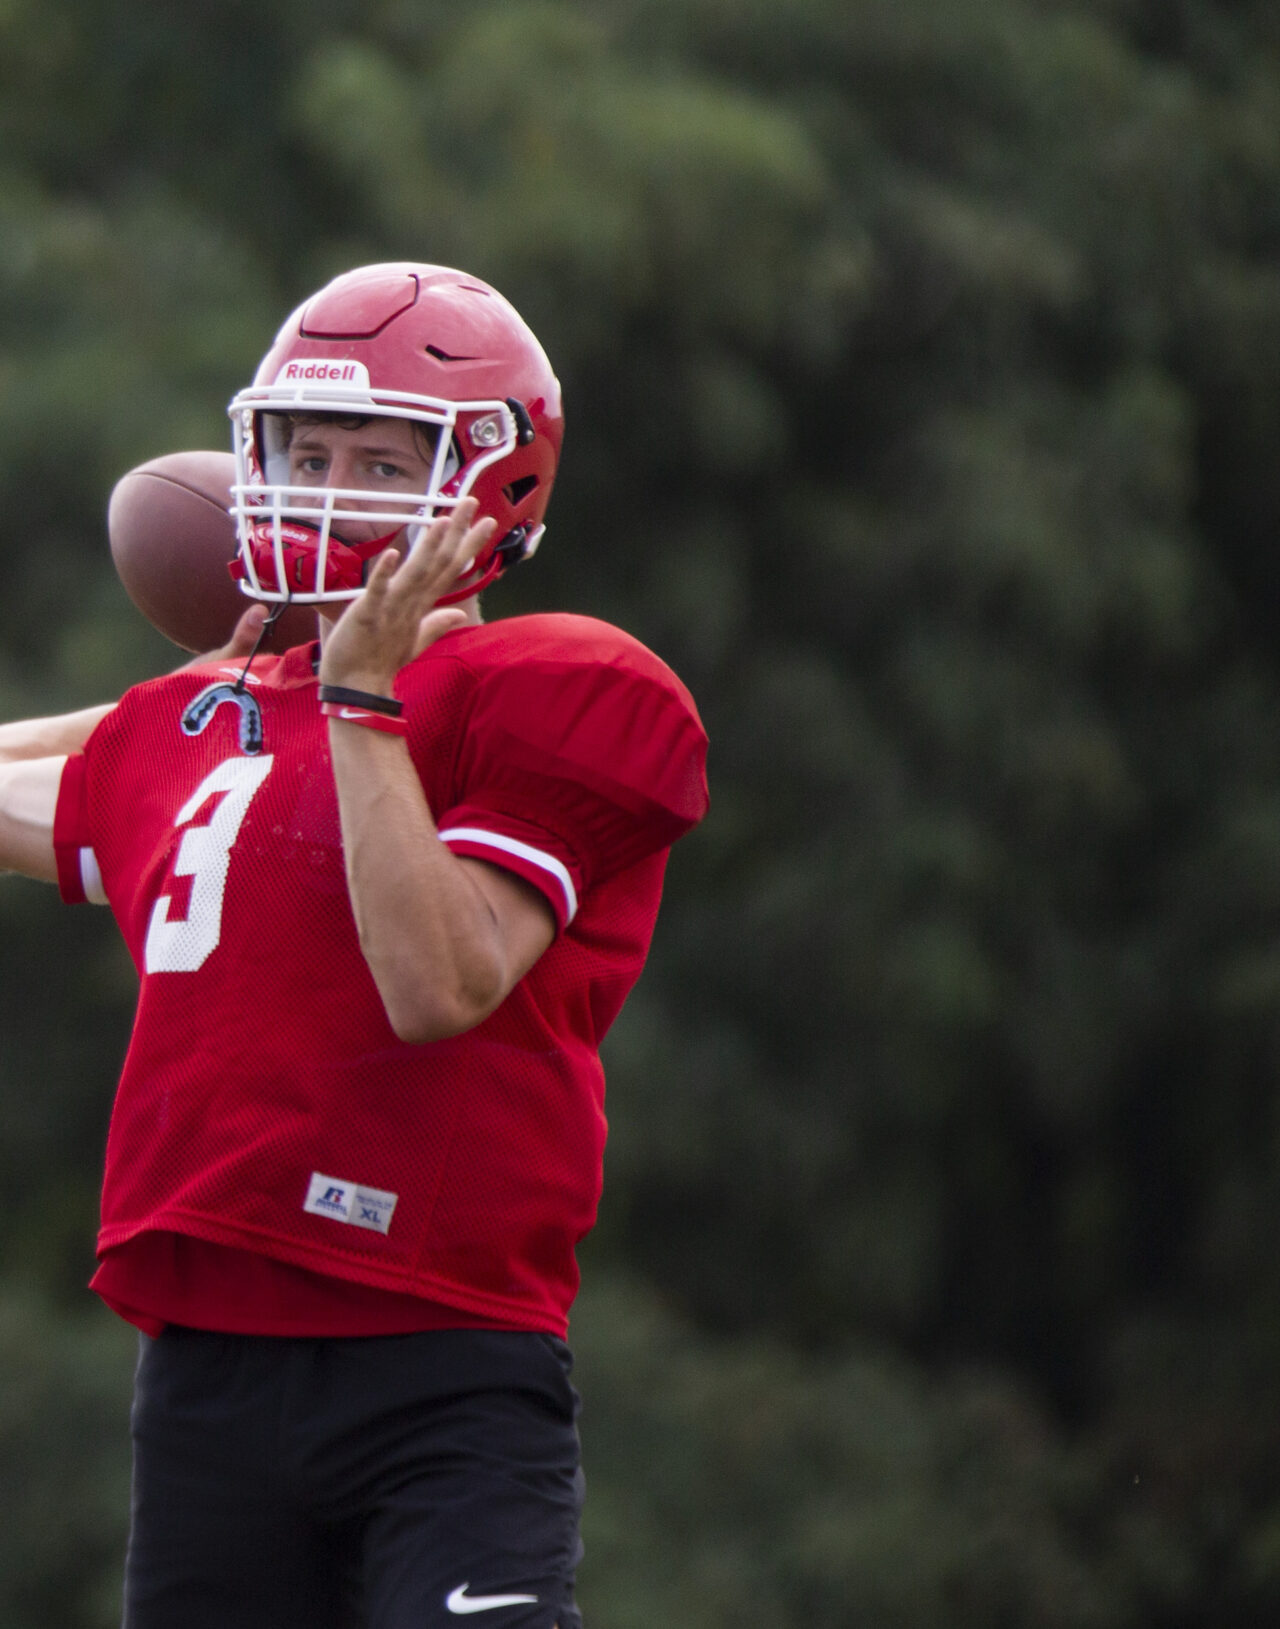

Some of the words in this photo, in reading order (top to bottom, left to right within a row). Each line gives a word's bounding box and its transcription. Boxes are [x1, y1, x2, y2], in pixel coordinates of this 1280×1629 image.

[286, 364, 356, 381] Riddell
[145, 754, 274, 975] 3
[360, 1207, 382, 1223] XL
